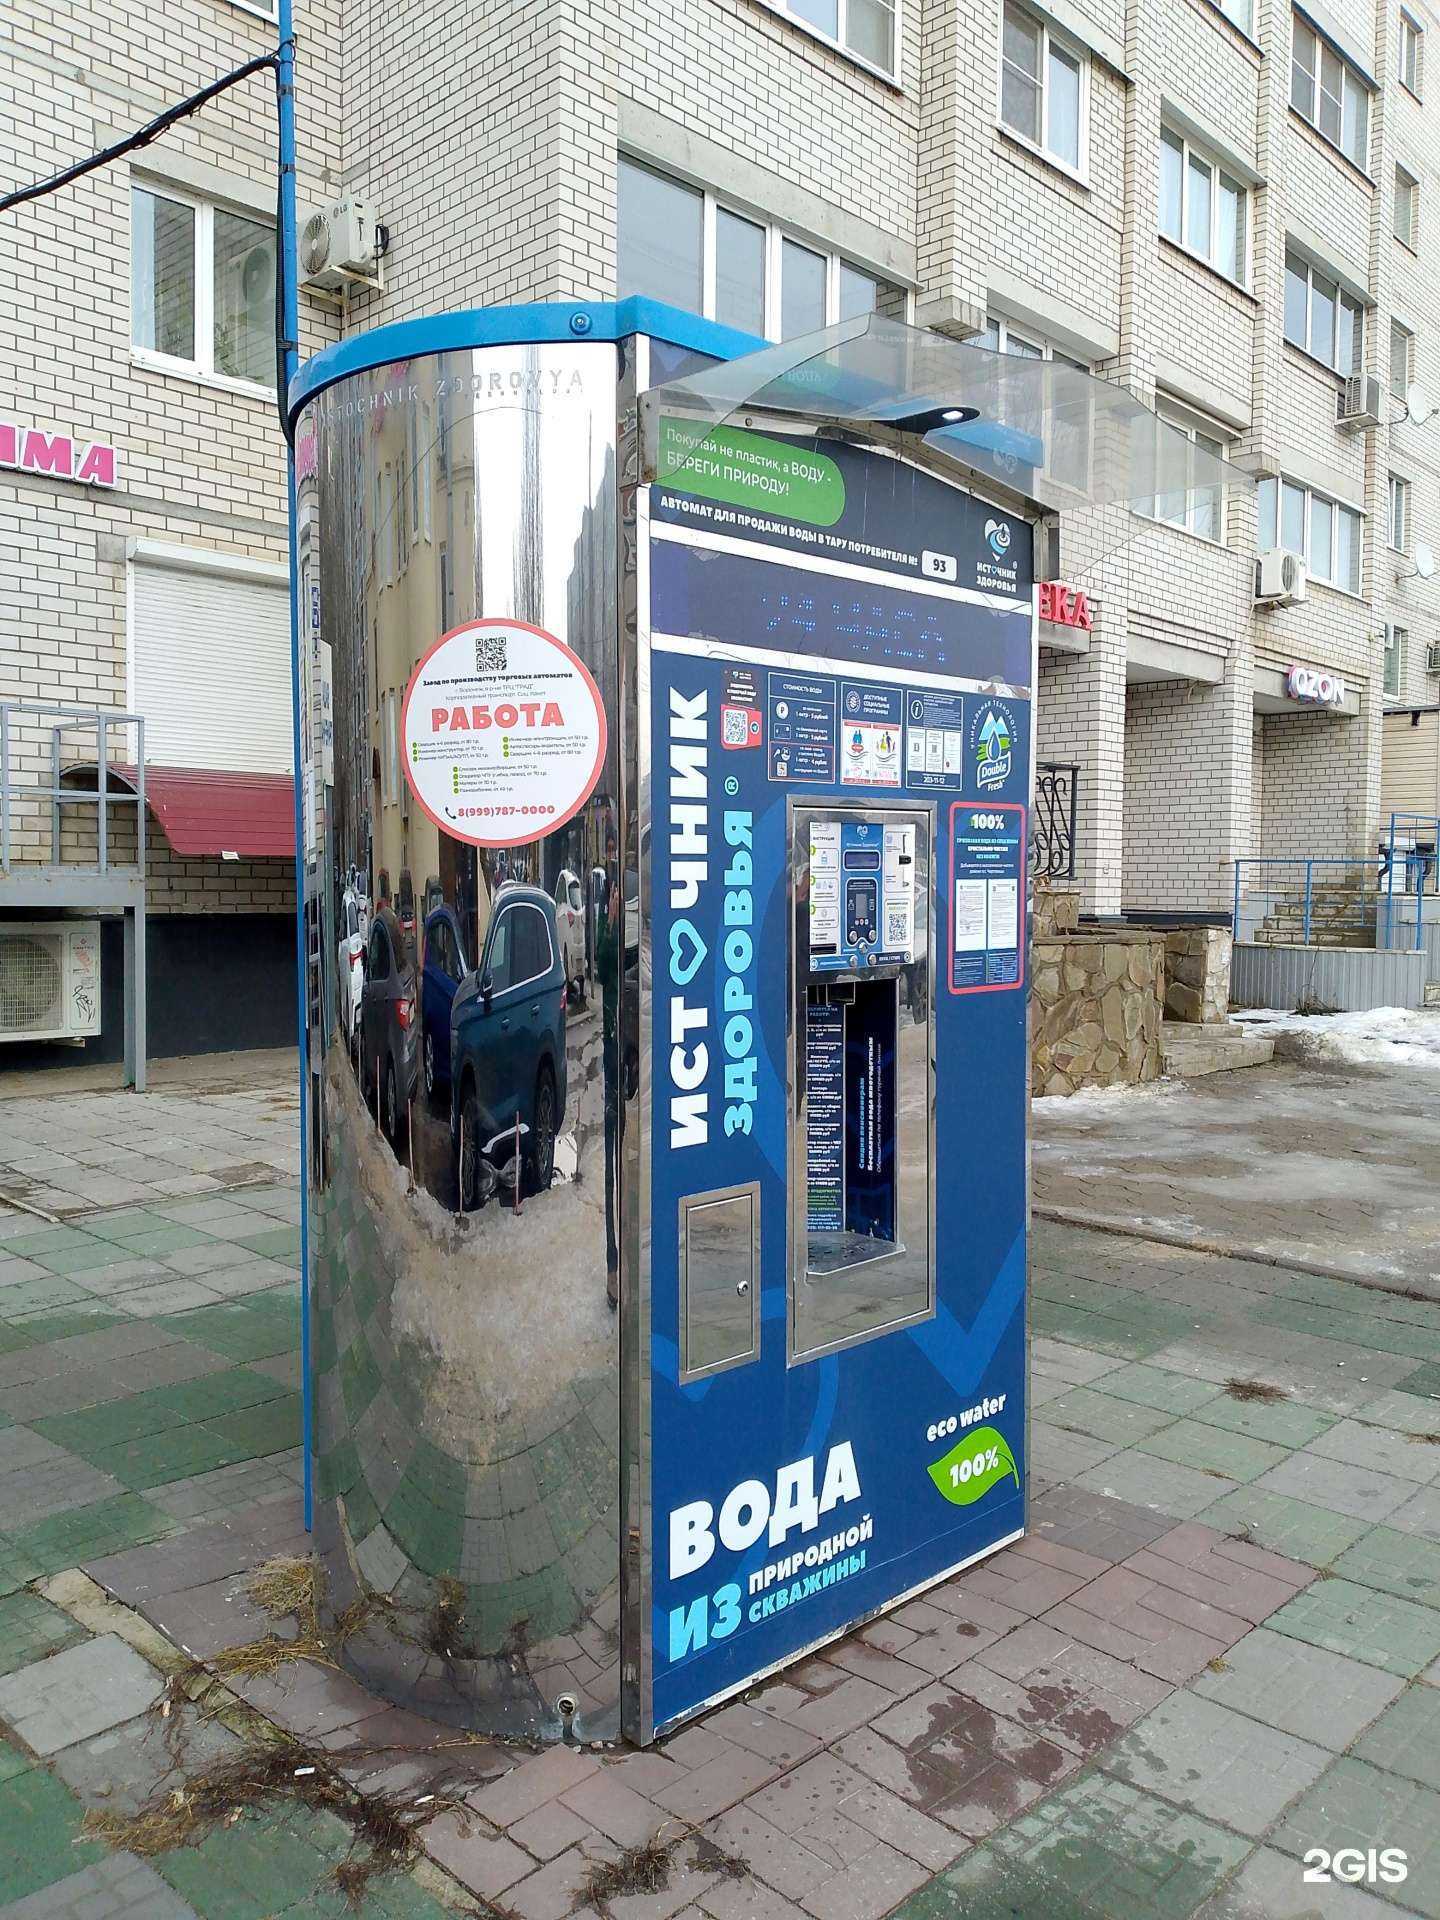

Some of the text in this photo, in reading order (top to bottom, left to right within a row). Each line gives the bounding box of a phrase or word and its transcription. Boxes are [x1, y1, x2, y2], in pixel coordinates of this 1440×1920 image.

[435, 368, 583, 396] ZDOROVYA
[667, 428, 717, 453] Покупай
[719, 444, 733, 457] не
[736, 448, 781, 473] пластик,
[783, 464, 789, 473] а
[791, 461, 825, 483] ВОДУ
[667, 451, 790, 497] БЕРЕГИ ПРИРОДУ!
[660, 495, 714, 518] АВТОМАТ
[713, 508, 736, 524] ДЛЯ
[737, 513, 788, 535] ПРОДАЖИ
[788, 526, 817, 543] ВОДЫ
[817, 532, 824, 544] В
[825, 535, 847, 550] ТАРУ
[849, 541, 908, 566] ПОТРЕБИТЕЛЯ
[933, 558, 946, 574] 93
[976, 574, 1017, 593] ЗДОРОВЬЯ
[450, 676, 497, 686] производству
[498, 674, 532, 682] торговых
[1293, 666, 1345, 706] OZON
[431, 702, 565, 733] РАБОТА
[970, 700, 992, 750] УНИКАЛЬНАЯ
[993, 699, 1018, 744] ТЕХНОЛОГИЯ
[981, 761, 1007, 778] Double
[458, 804, 556, 818] 8(999)787-0000
[971, 813, 1005, 831] 100%
[724, 810, 758, 1138] ЗДОРОВЬЯ
[926, 1393, 1007, 1442] eco water
[949, 1446, 999, 1488] 100%
[669, 1441, 861, 1580] ВОДА
[749, 1513, 873, 1594] ПРИРОДНОЙ
[669, 1550, 866, 1663] ИЗ СКВАЖИНЫ
